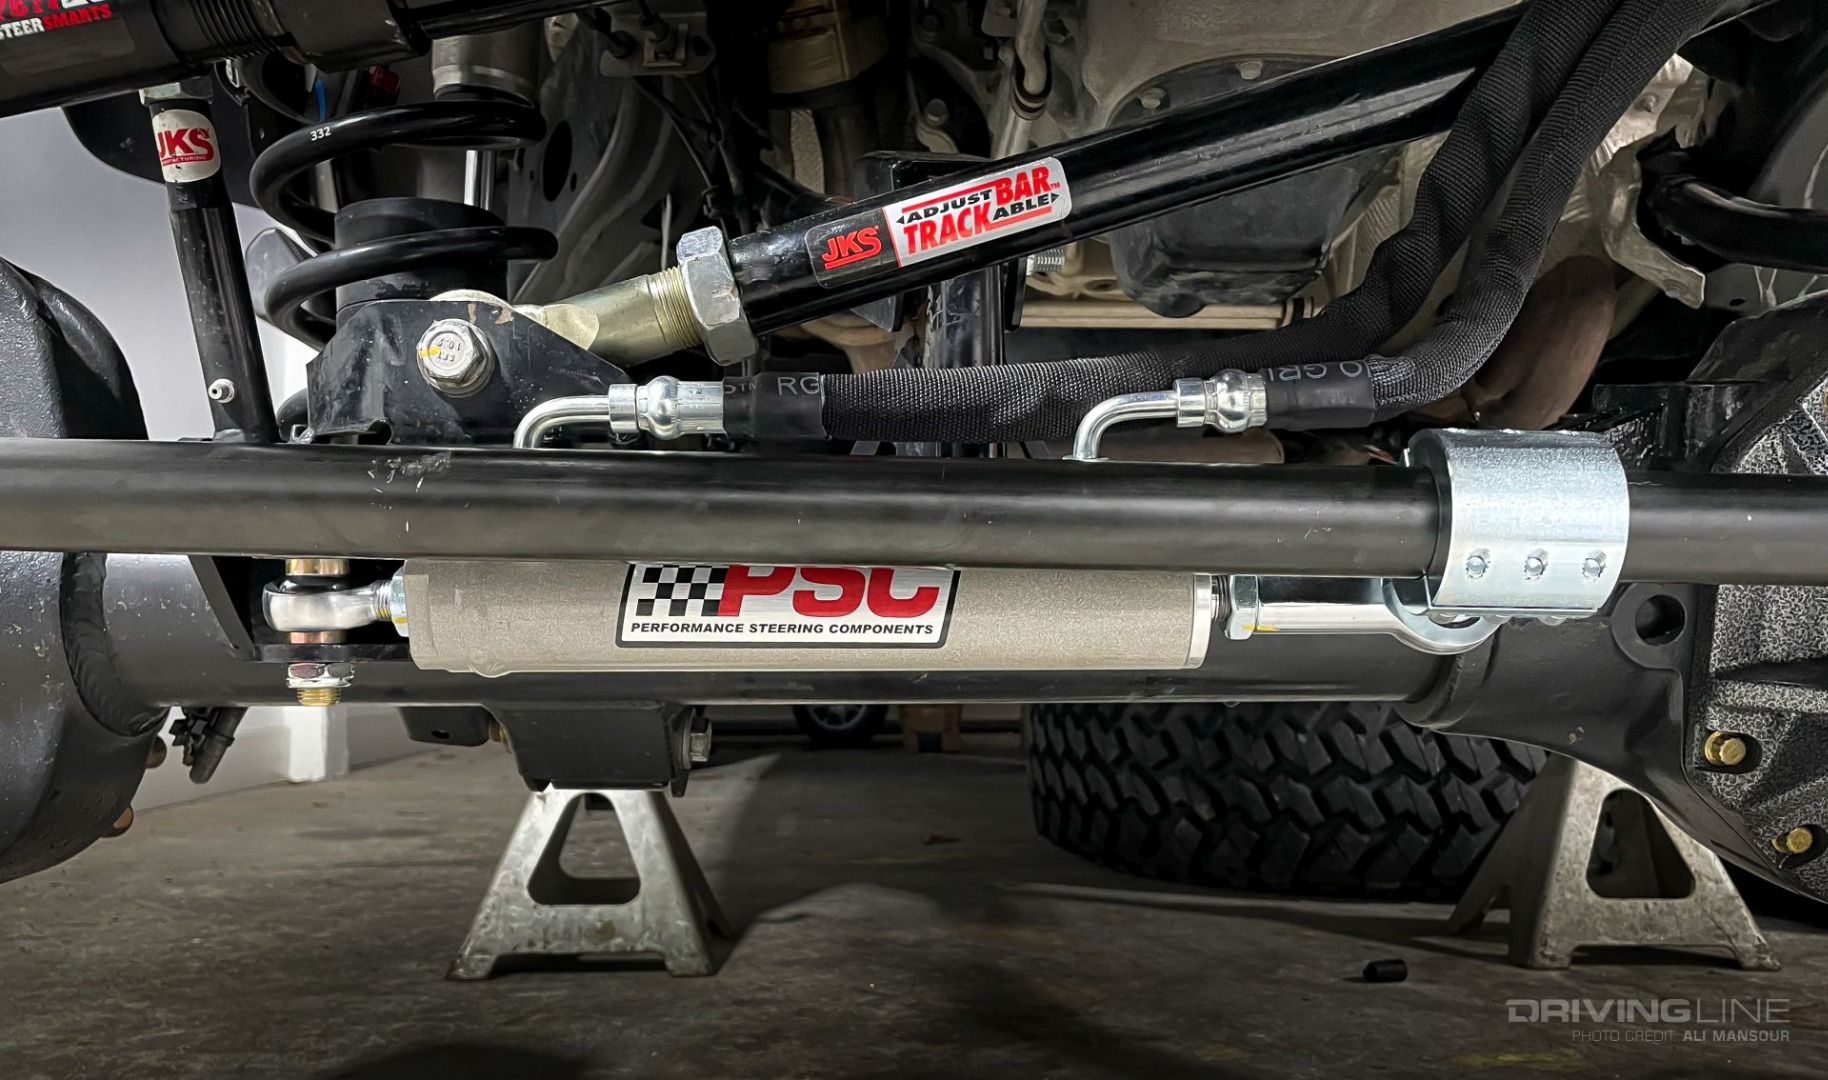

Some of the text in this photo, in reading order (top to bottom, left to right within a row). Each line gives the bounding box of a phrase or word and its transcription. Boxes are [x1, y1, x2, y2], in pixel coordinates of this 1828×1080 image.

[158, 127, 214, 161] JKS
[310, 126, 331, 141] 332
[901, 189, 993, 225] ADJUST
[995, 166, 1051, 206] BAR
[903, 194, 1050, 255] TRACK ABLE
[821, 226, 883, 270] JKS
[717, 564, 940, 618] PSC
[631, 623, 934, 635] PERFORMANCE STEERING COMPONENTS
